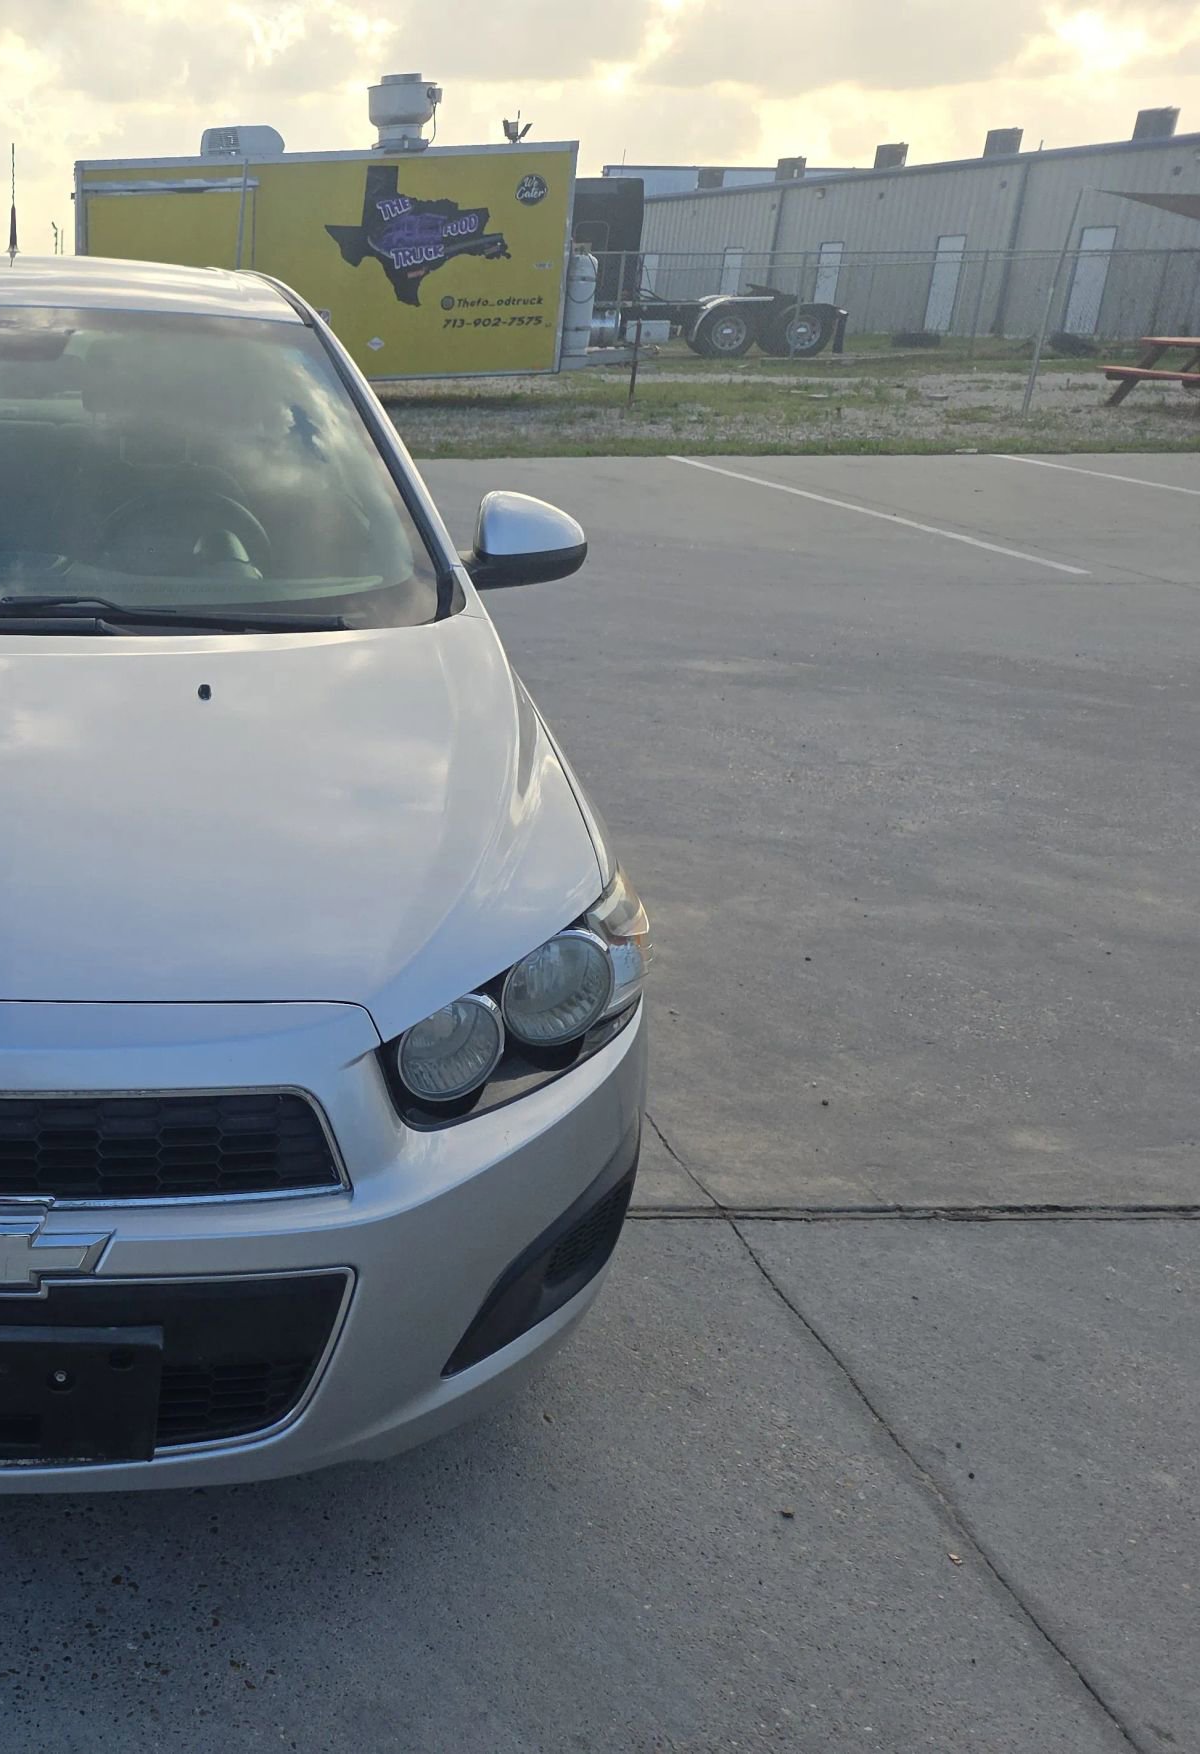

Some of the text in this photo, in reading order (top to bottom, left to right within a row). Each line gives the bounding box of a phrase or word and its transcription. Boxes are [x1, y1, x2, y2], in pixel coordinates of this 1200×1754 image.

[376, 197, 412, 221] THE
[443, 213, 479, 237] FOOD
[390, 244, 445, 269] TRUCK
[443, 315, 543, 328] 713-902-7575
